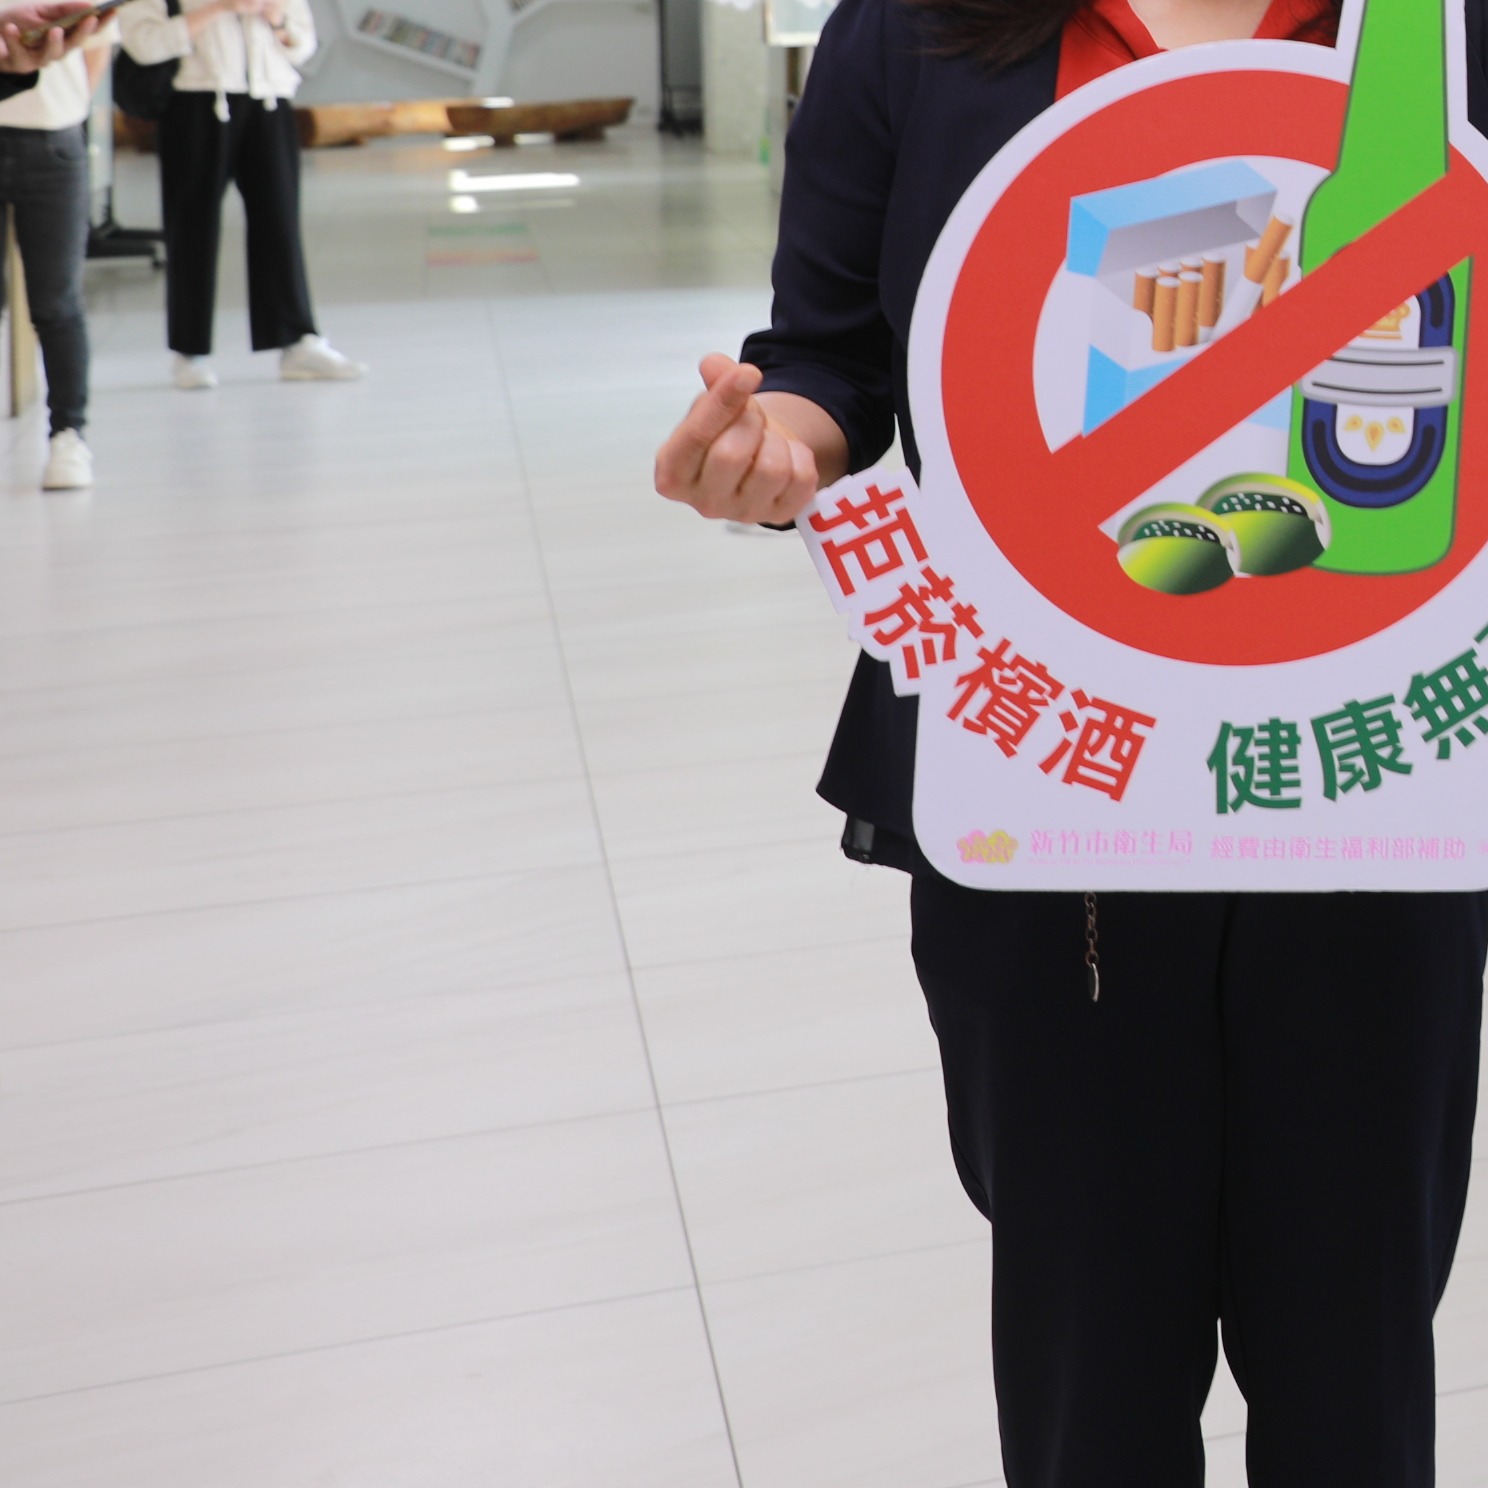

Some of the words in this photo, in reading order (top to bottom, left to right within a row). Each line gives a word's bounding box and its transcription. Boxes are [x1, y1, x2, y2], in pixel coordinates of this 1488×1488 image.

[808, 484, 1157, 803] 拒菸檳酒
[1030, 828, 1193, 855] 新竹市衛生局
[1211, 835, 1466, 861] 經費由衛生福利部補助
